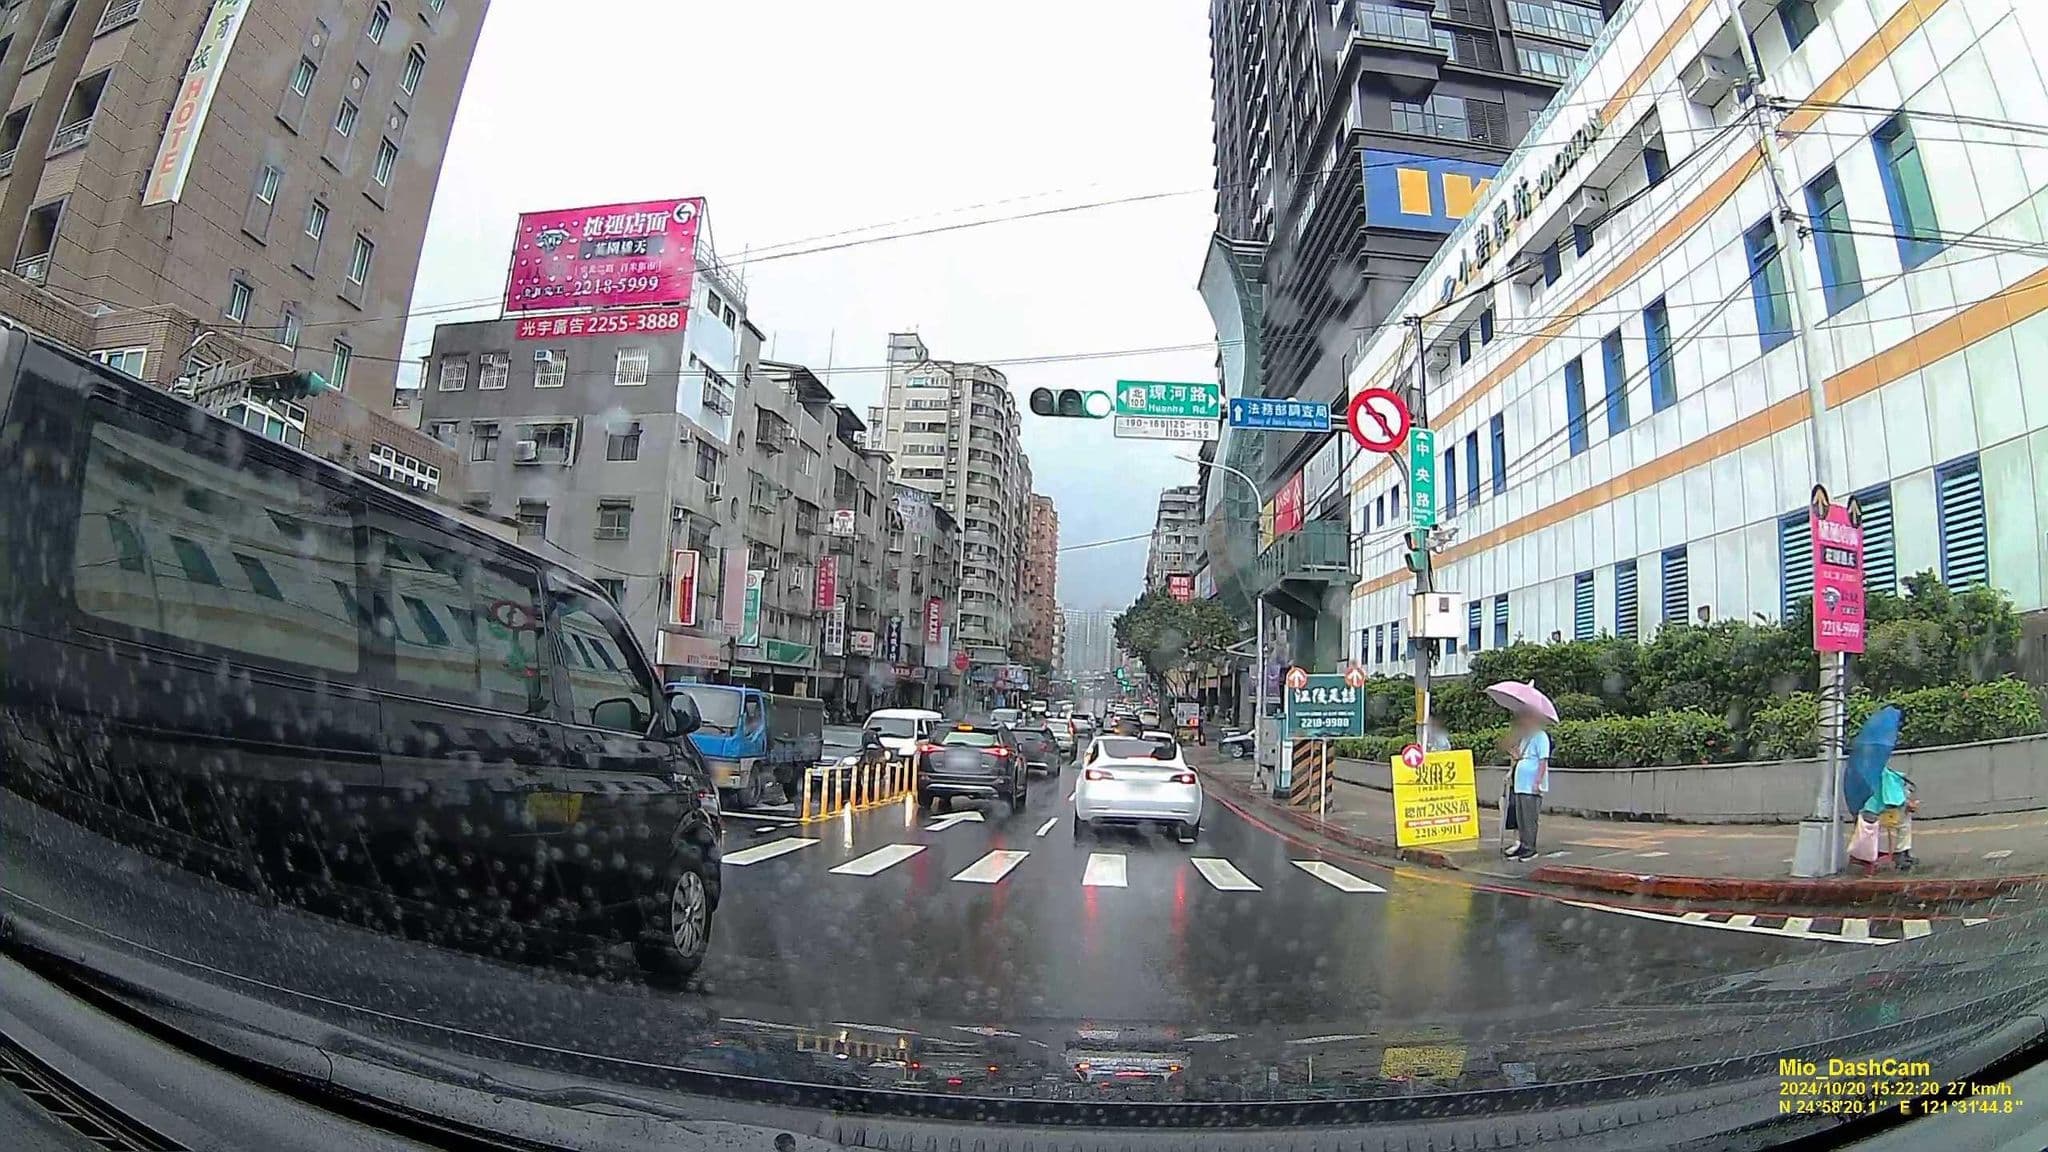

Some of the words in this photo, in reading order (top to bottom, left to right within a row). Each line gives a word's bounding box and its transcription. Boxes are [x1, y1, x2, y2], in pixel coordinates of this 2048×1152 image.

[151, 77, 205, 199] HOTEL
[583, 211, 671, 237] 捷運店面
[573, 276, 659, 296] 2218-5999
[521, 317, 585, 337] 光宇廣告
[587, 312, 679, 333] 2255-3888
[1149, 385, 1206, 402] 環河路
[1149, 404, 1185, 414] Huanhe
[1192, 405, 1208, 415] Rd.
[1248, 401, 1327, 418] 法務部調查局
[1415, 442, 1431, 507] 中央路
